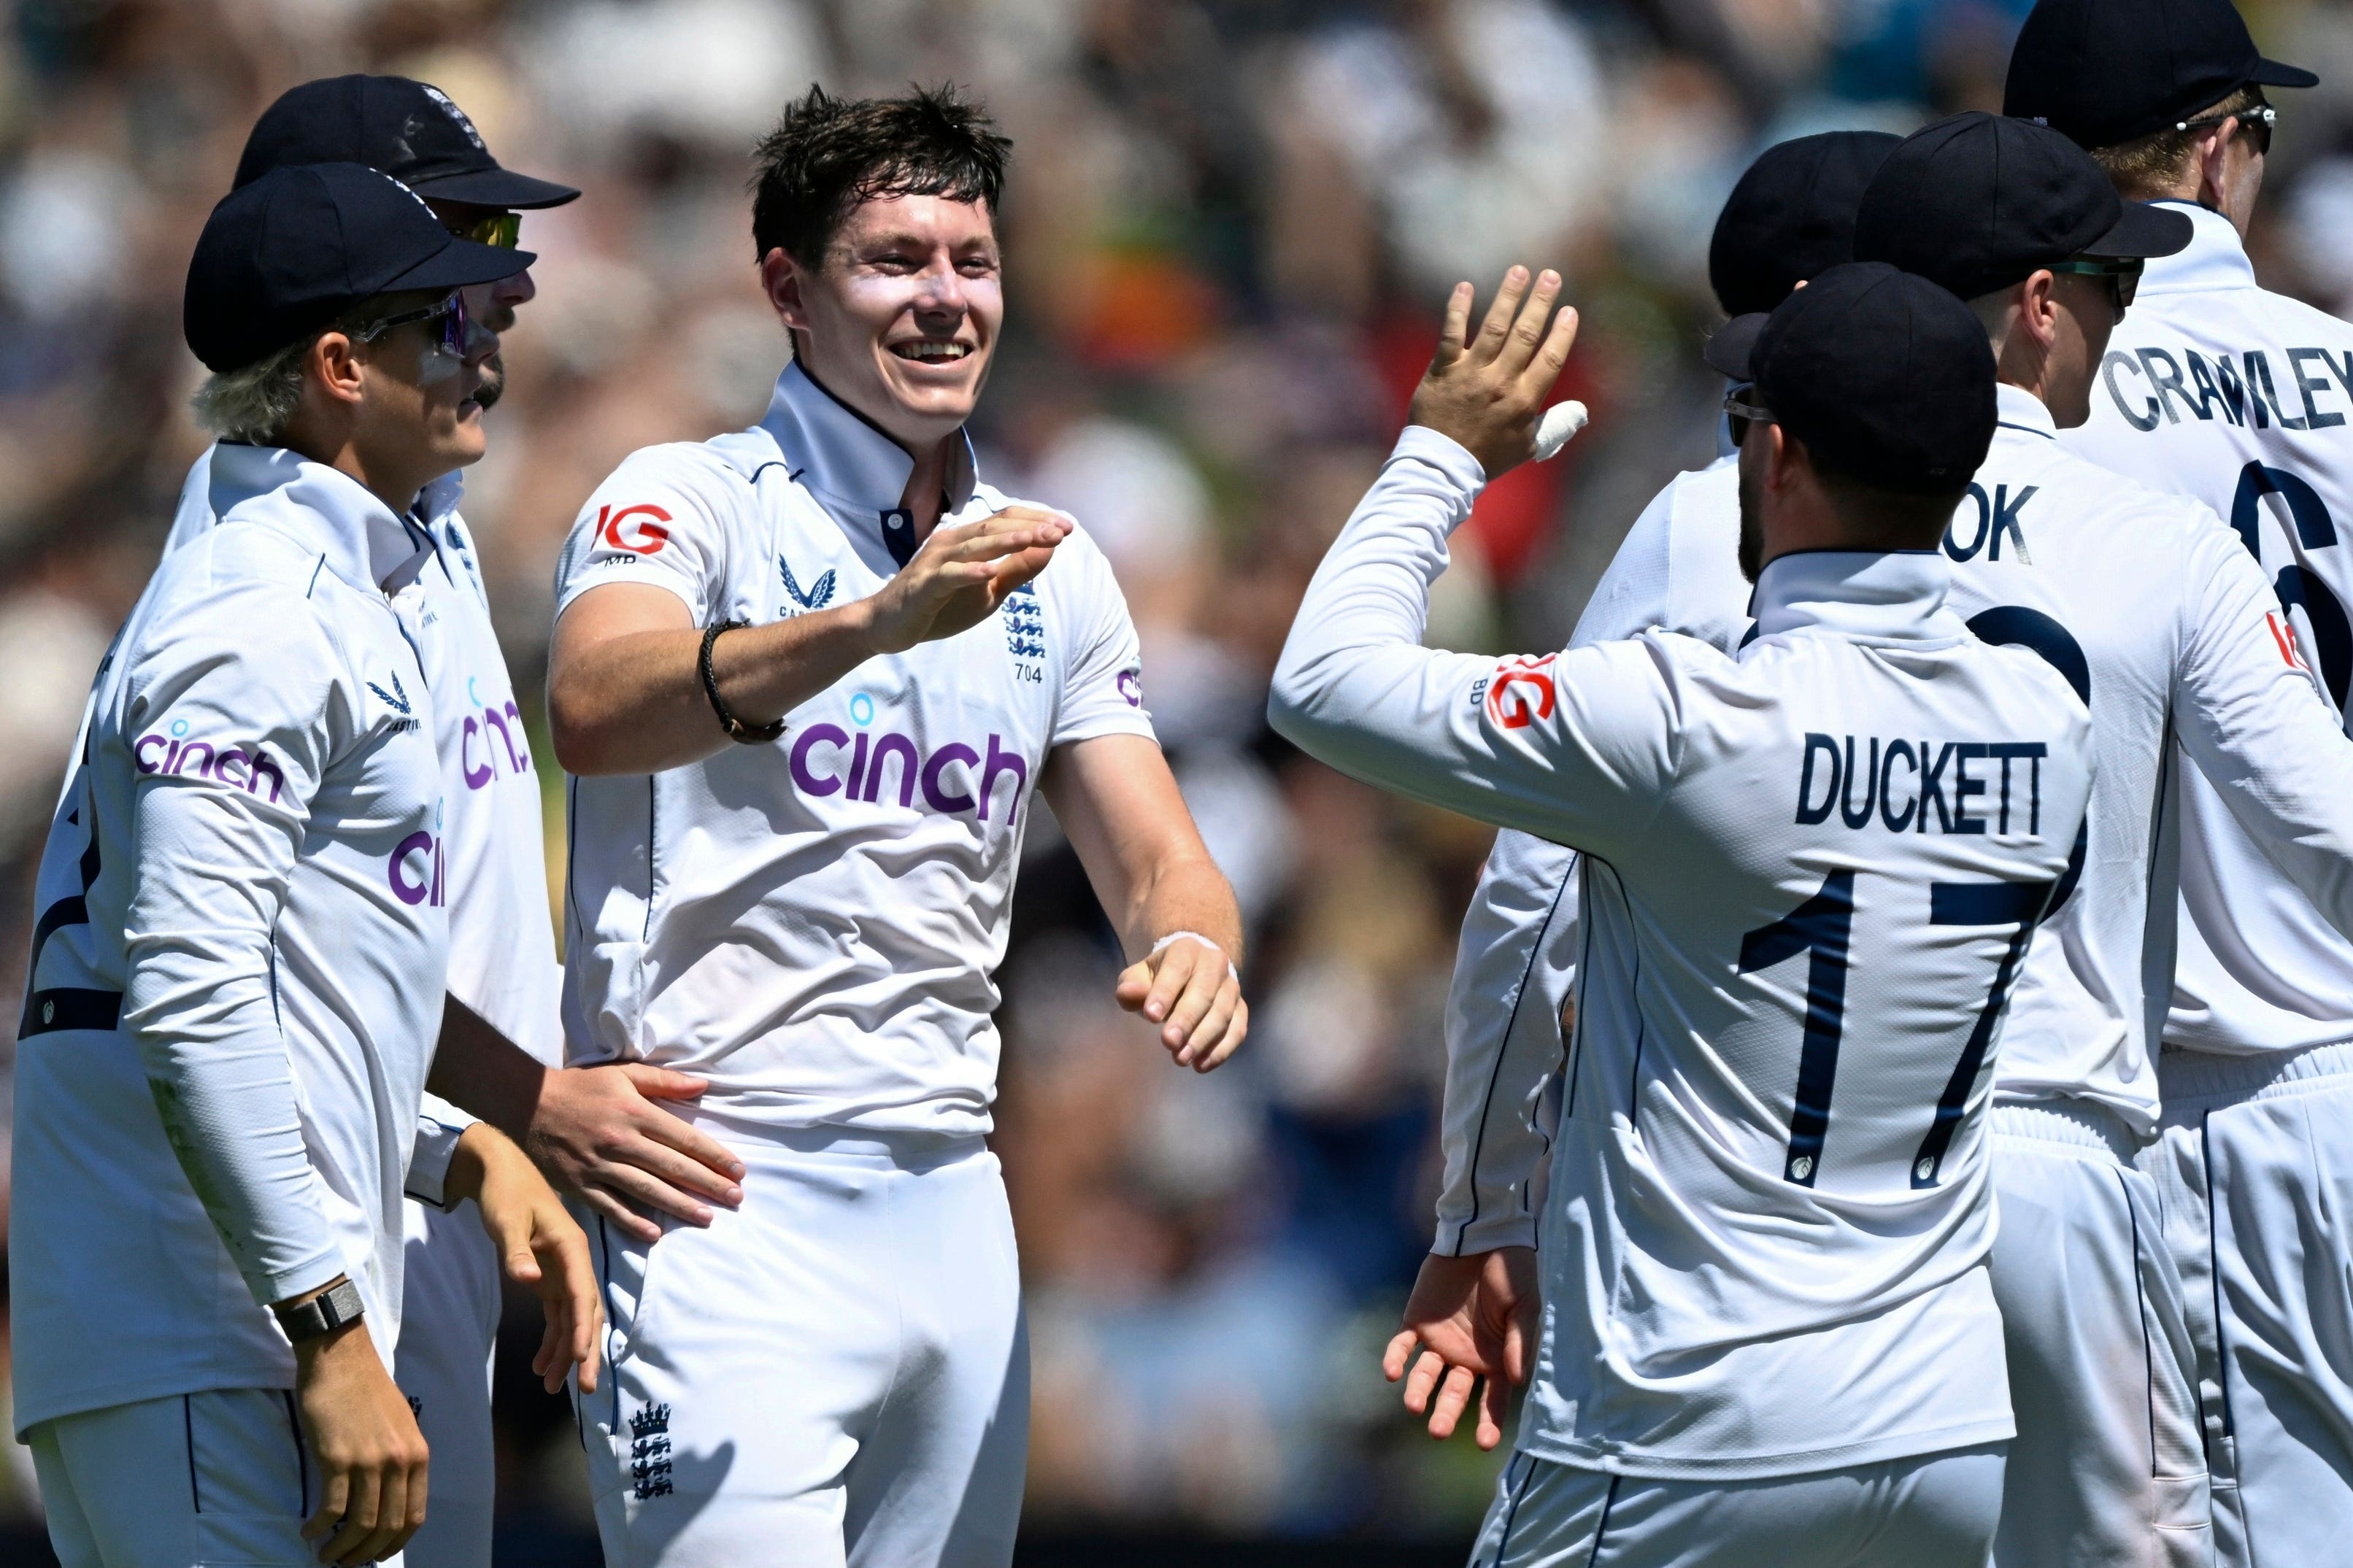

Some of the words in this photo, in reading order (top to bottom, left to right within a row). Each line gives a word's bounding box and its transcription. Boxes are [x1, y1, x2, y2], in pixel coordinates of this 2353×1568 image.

[590, 503, 673, 555] IG
[1014, 663, 1042, 684] 704
[1470, 677, 1489, 705] BD
[135, 719, 284, 804] cinch
[790, 692, 1027, 826] cinch
[1795, 732, 2048, 835] DUCKETT
[1738, 868, 2058, 1189] 17
